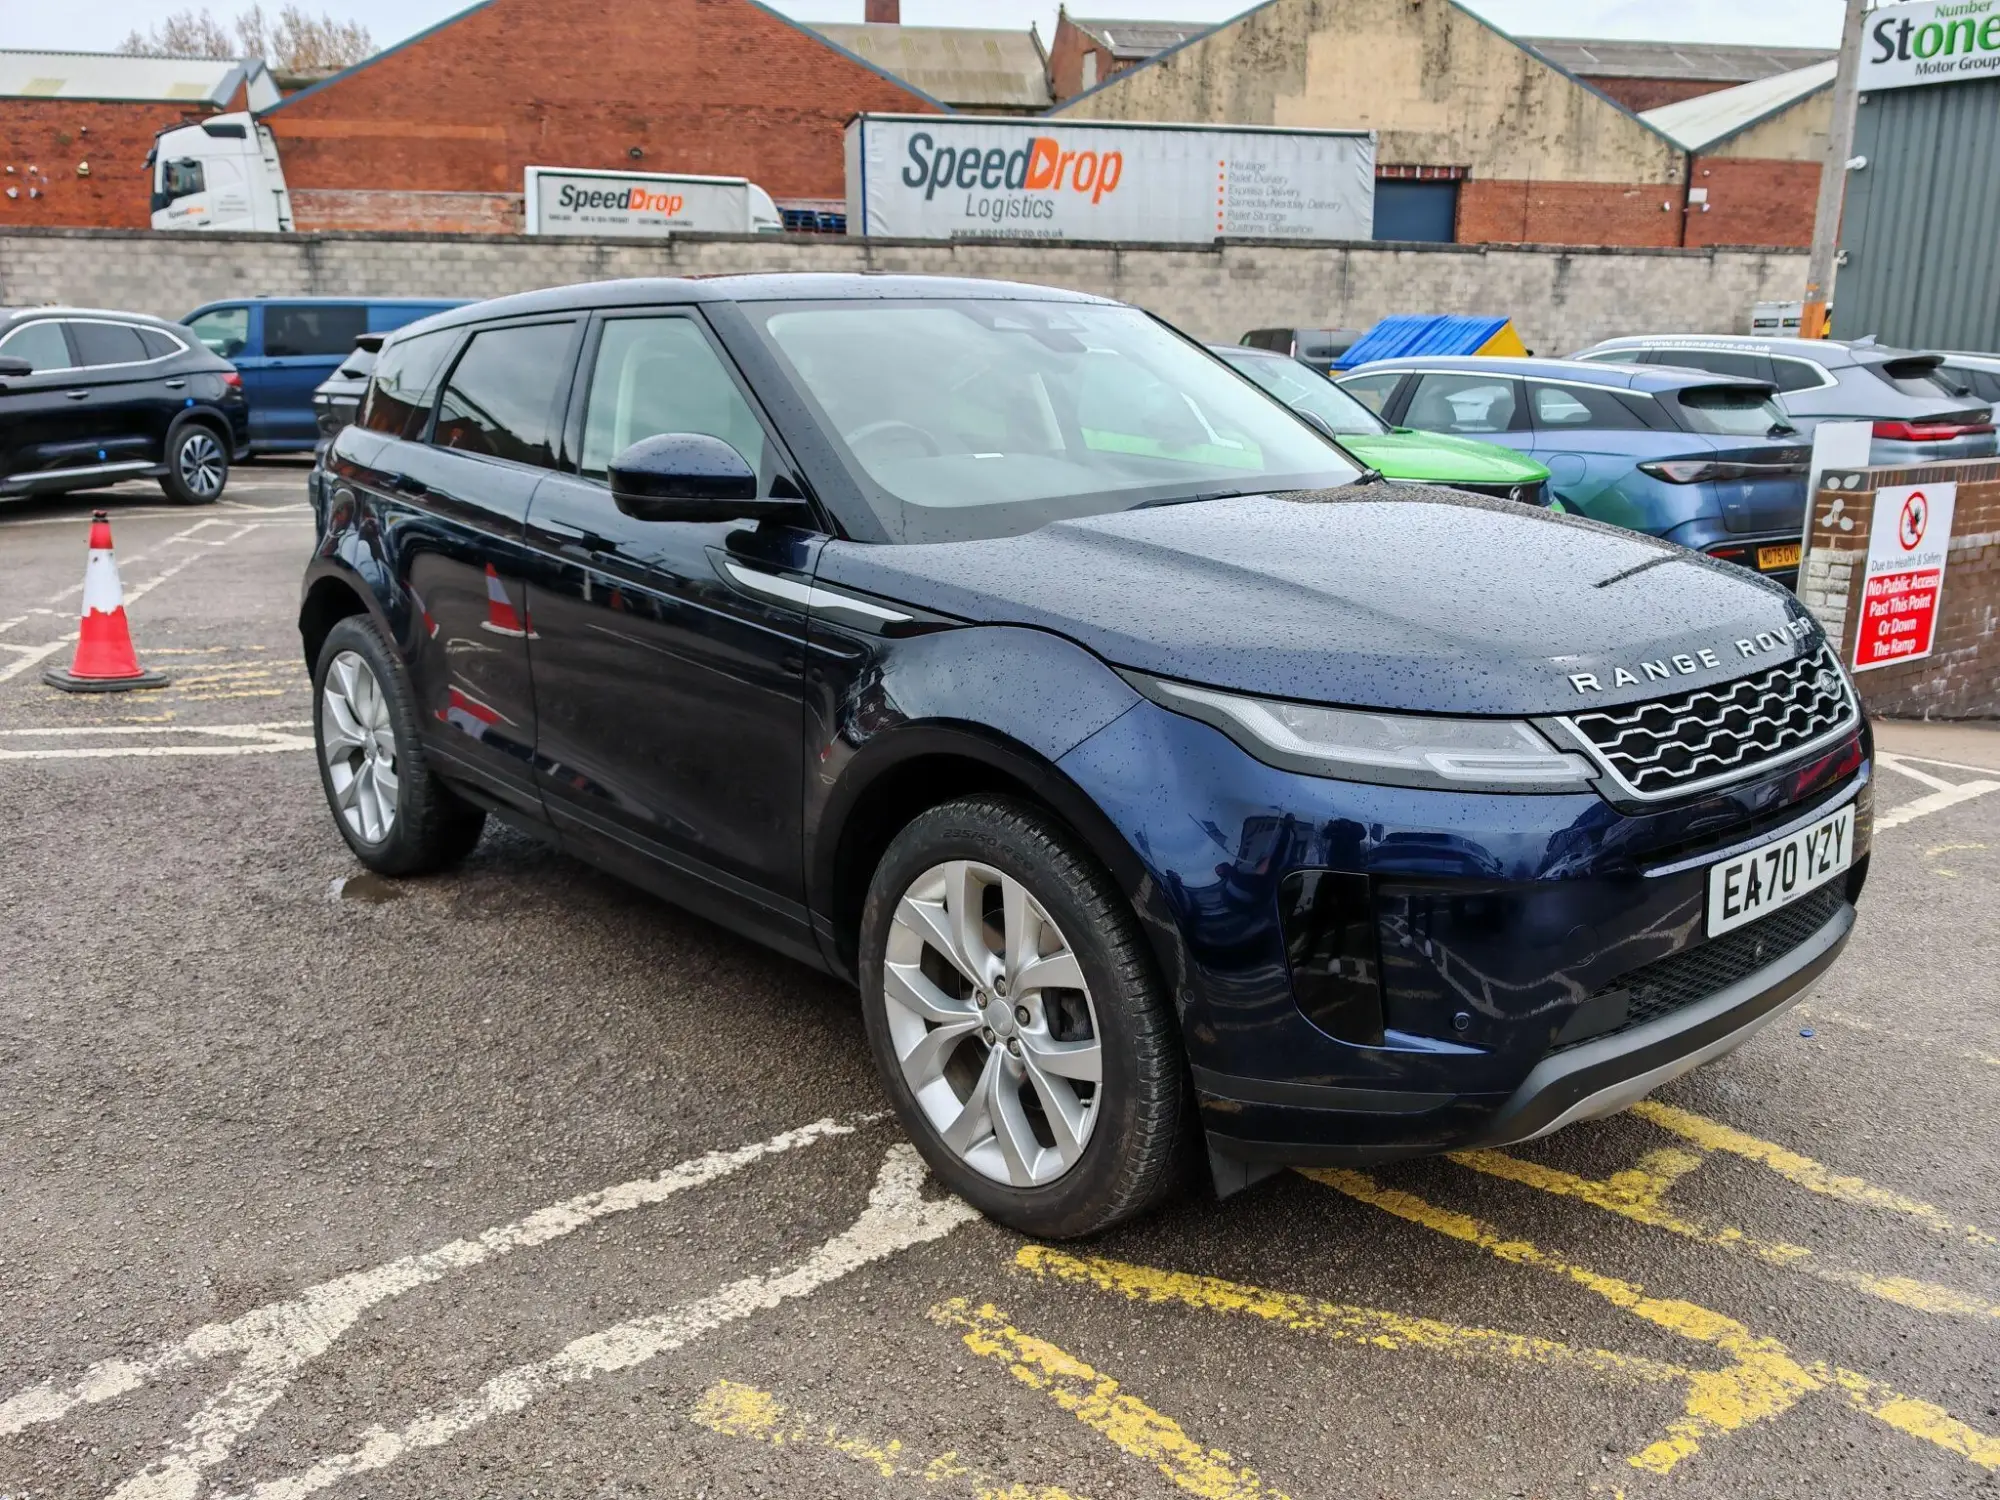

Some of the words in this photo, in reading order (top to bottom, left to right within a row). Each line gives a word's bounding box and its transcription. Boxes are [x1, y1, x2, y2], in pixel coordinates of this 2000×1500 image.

[1935, 0, 1992, 18] Number
[1870, 14, 2000, 64] Stone
[1915, 61, 1957, 76] Motor
[1959, 55, 2000, 71] Group
[902, 132, 1123, 205] SpeedDrop
[559, 184, 683, 216] SpeedDrop
[1266, 185, 1300, 198] Delivery
[965, 194, 1054, 223] Logistics
[1307, 199, 1342, 212] Delivery
[950, 228, 1064, 239] www.speeddrop.co.uk
[1642, 340, 1772, 353] www.stoneacre.co.uk
[1872, 560, 1885, 571] Due
[1887, 560, 1894, 569] to
[1895, 554, 1916, 569] Health
[1923, 551, 1942, 566] Safety
[1868, 580, 1882, 596] No
[1882, 575, 1910, 594] Public
[1911, 574, 1939, 590] Access
[1869, 600, 1889, 617] Past
[1890, 596, 1908, 613] This
[1908, 594, 1932, 611] Point
[1878, 620, 1891, 636] Or
[1890, 618, 1917, 634] Down
[1568, 648, 1721, 694] RANGE
[1735, 616, 1815, 659] ROVER
[1873, 640, 1890, 657] The
[1890, 638, 1916, 655] Ramp
[1722, 841, 1798, 921] EA70
[1806, 815, 1847, 881] YZY
